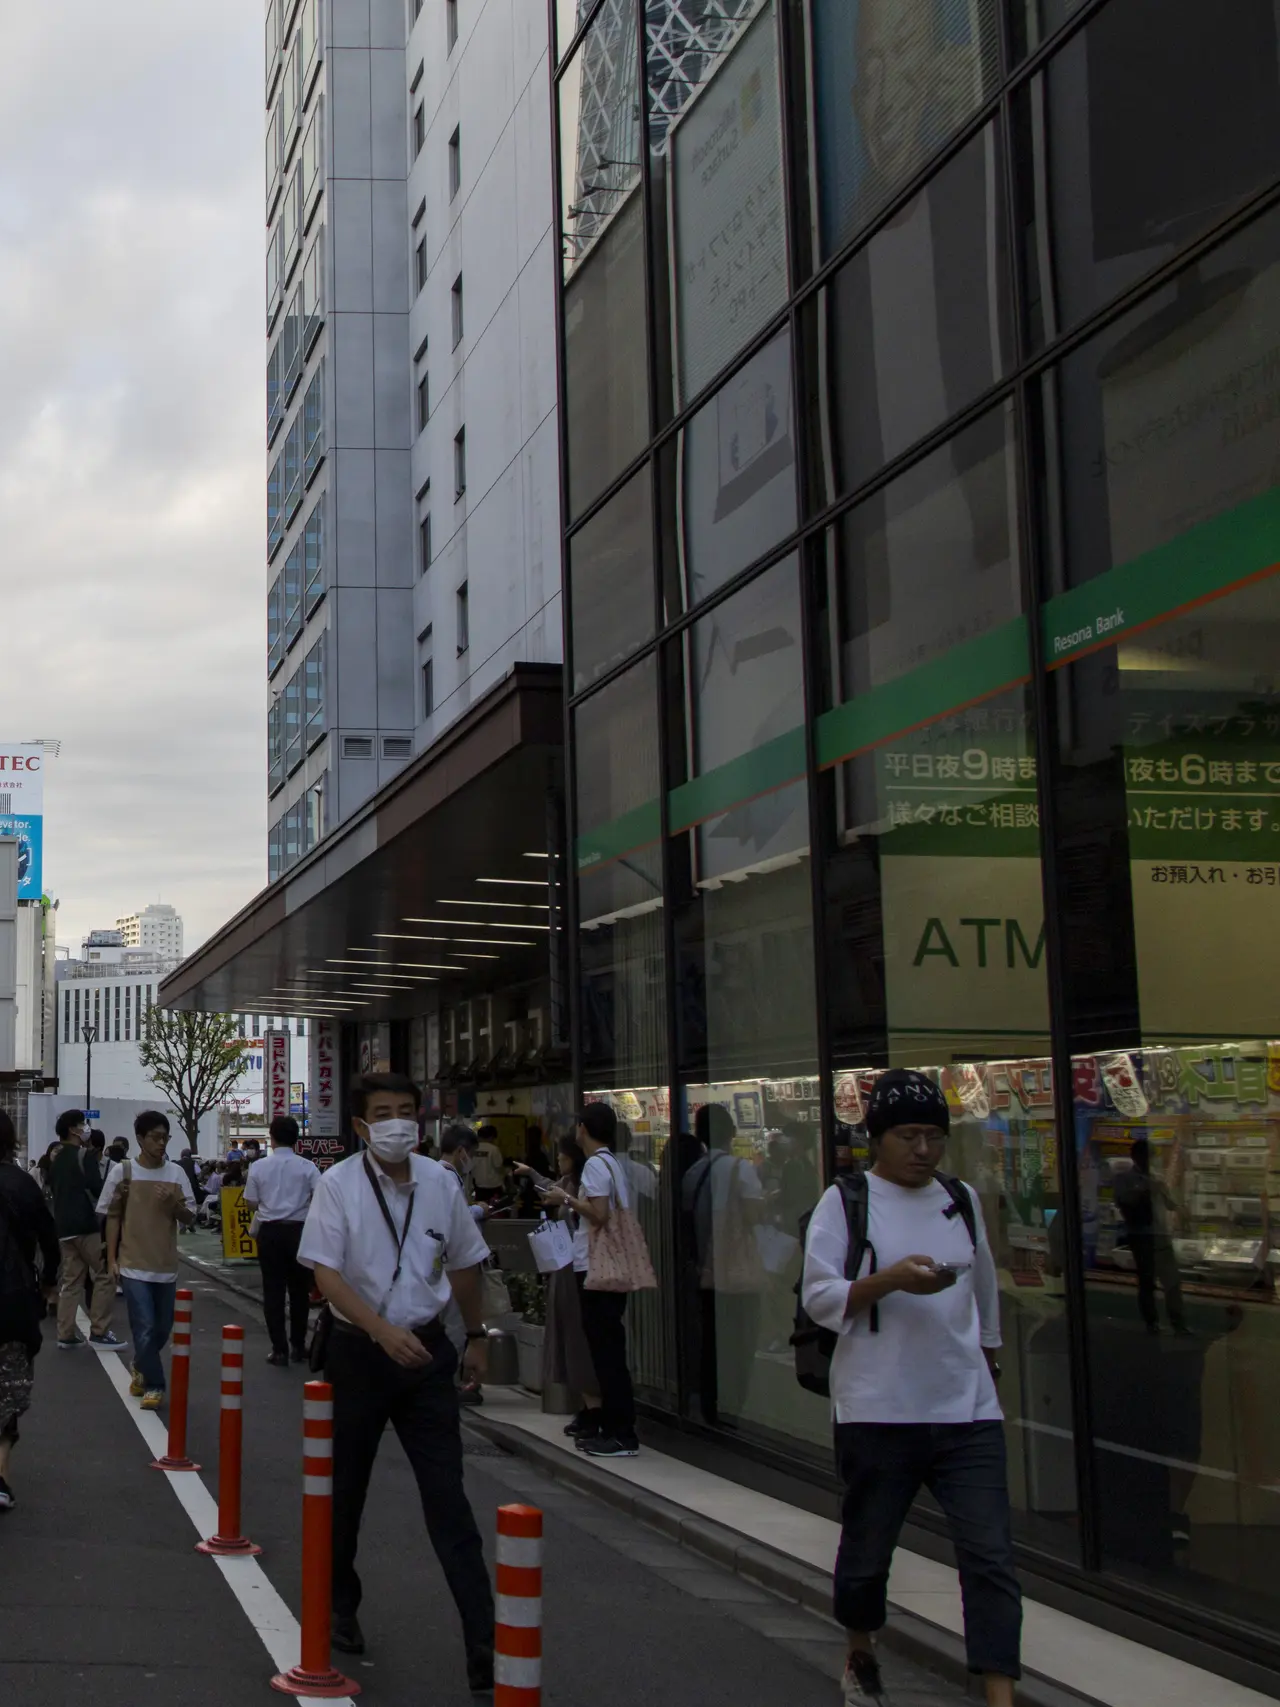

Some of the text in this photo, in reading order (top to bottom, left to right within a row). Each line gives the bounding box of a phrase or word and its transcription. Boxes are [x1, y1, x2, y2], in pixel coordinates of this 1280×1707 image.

[1053, 606, 1125, 654] Resona Bank
[884, 748, 1038, 782] 平日夜9時ま
[913, 917, 1047, 969] ATM
[238, 1208, 253, 1254] 出入口
